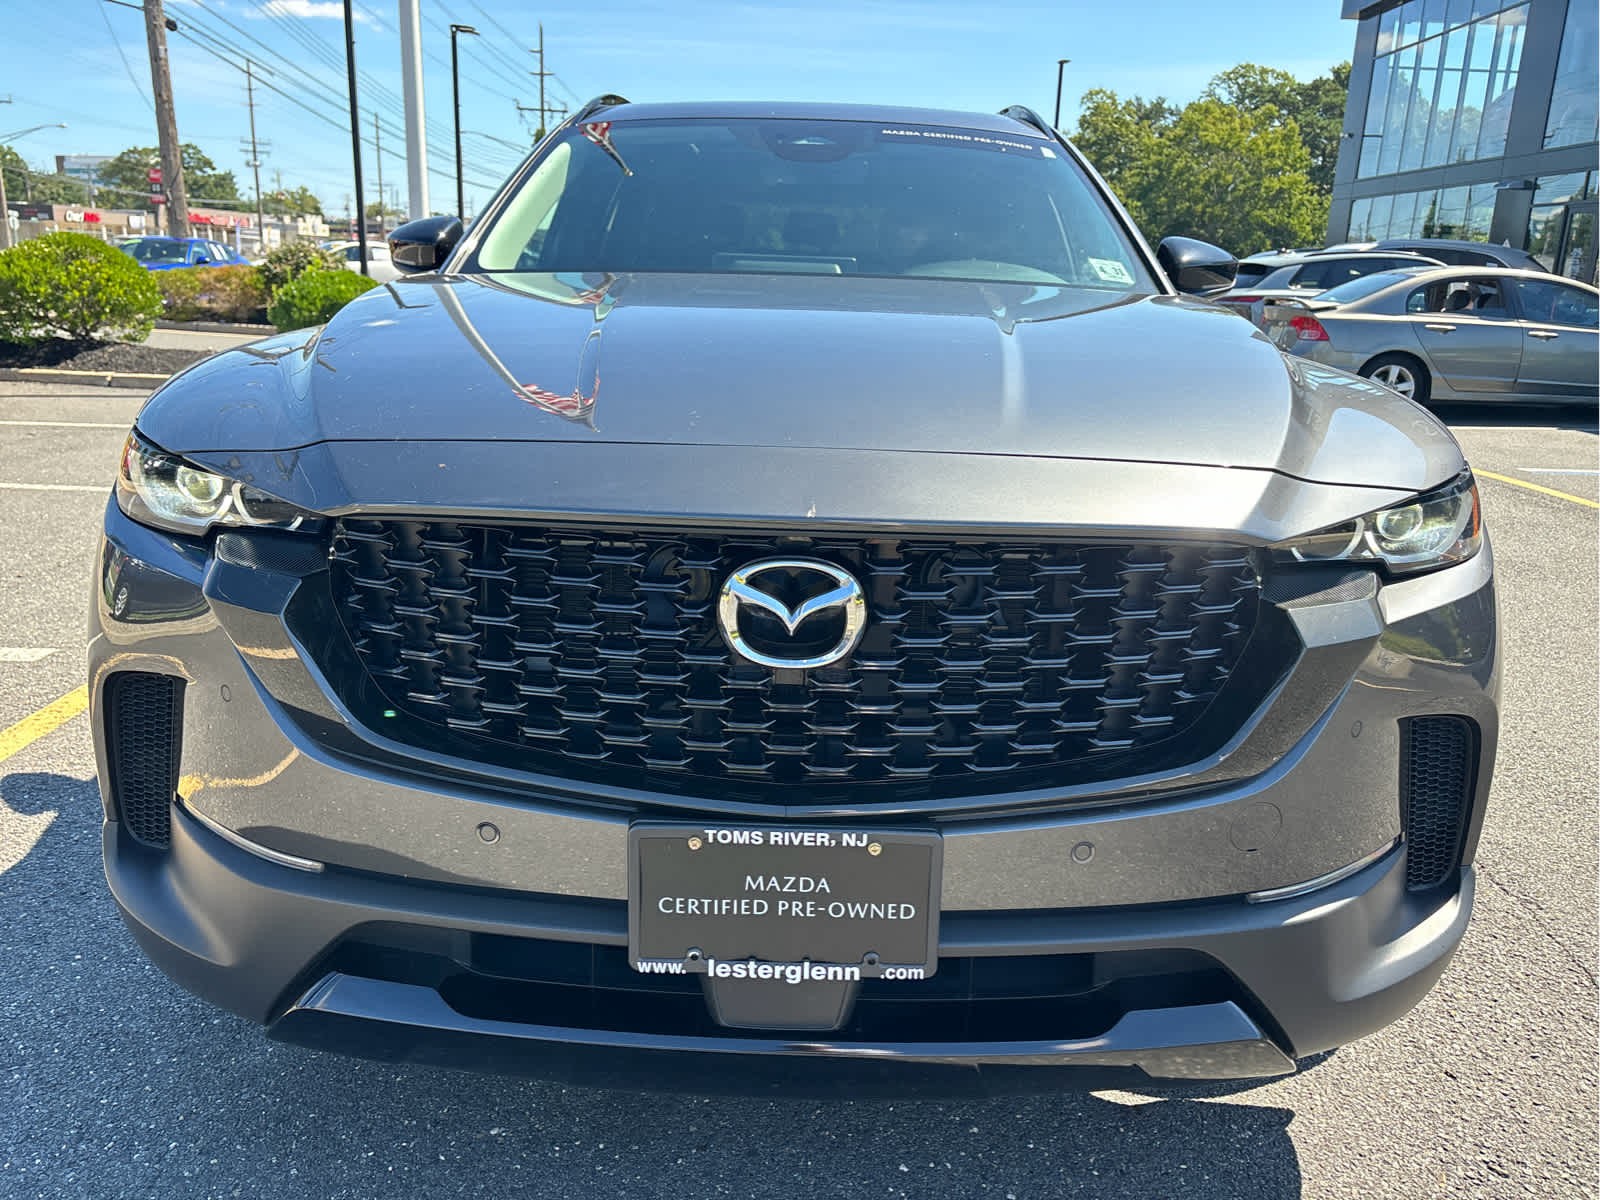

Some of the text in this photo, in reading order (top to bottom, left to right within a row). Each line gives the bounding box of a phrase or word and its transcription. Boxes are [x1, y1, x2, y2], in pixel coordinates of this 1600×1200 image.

[882, 129, 1033, 150] MAZDA CERTIFIED PRE-OWNED
[704, 829, 868, 848] TOMS RIVER, NJ
[744, 876, 831, 894] MAZDA
[658, 897, 915, 920] CERTIFIED PRE-OWNED
[637, 958, 924, 984] www. lesterglenn .com
